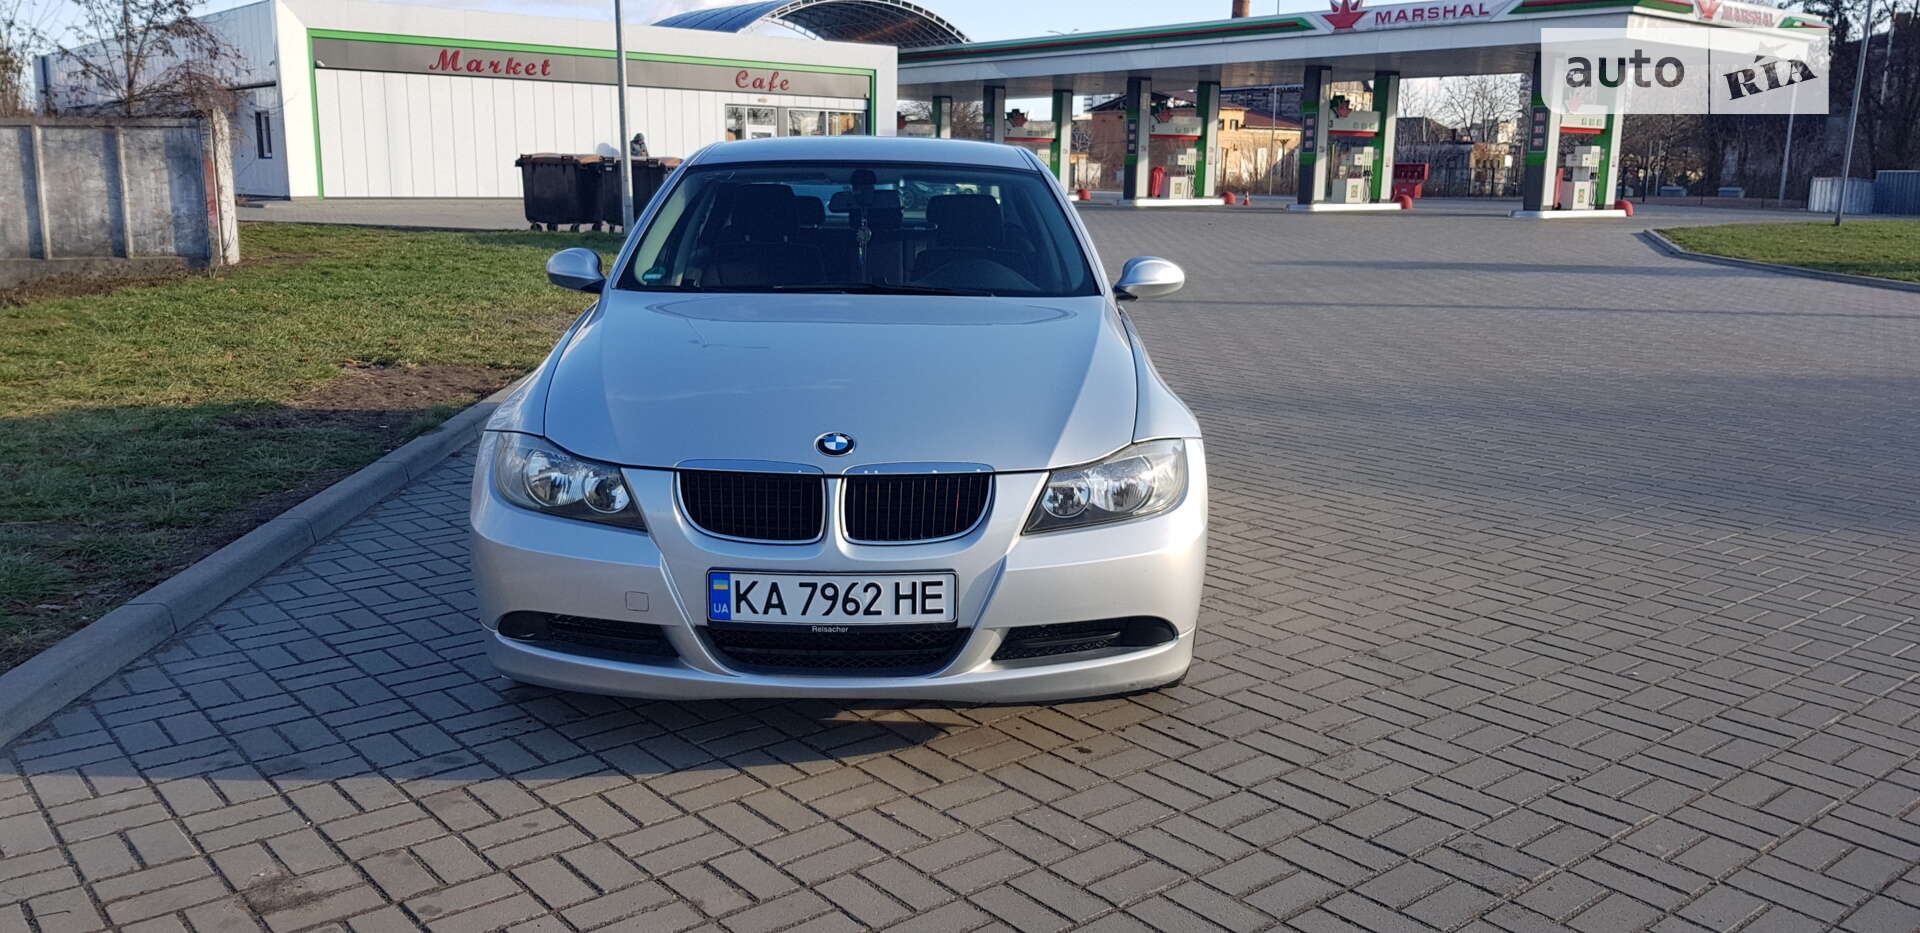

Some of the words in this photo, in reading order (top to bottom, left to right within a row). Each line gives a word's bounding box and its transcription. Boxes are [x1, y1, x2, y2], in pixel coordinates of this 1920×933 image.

[1375, 3, 1489, 24] MARSHAL
[429, 48, 552, 77] Market
[735, 70, 790, 92] Cafe
[713, 602, 729, 614] UA
[734, 580, 788, 616] KA
[798, 582, 882, 616] 7962
[894, 580, 944, 616] HE
